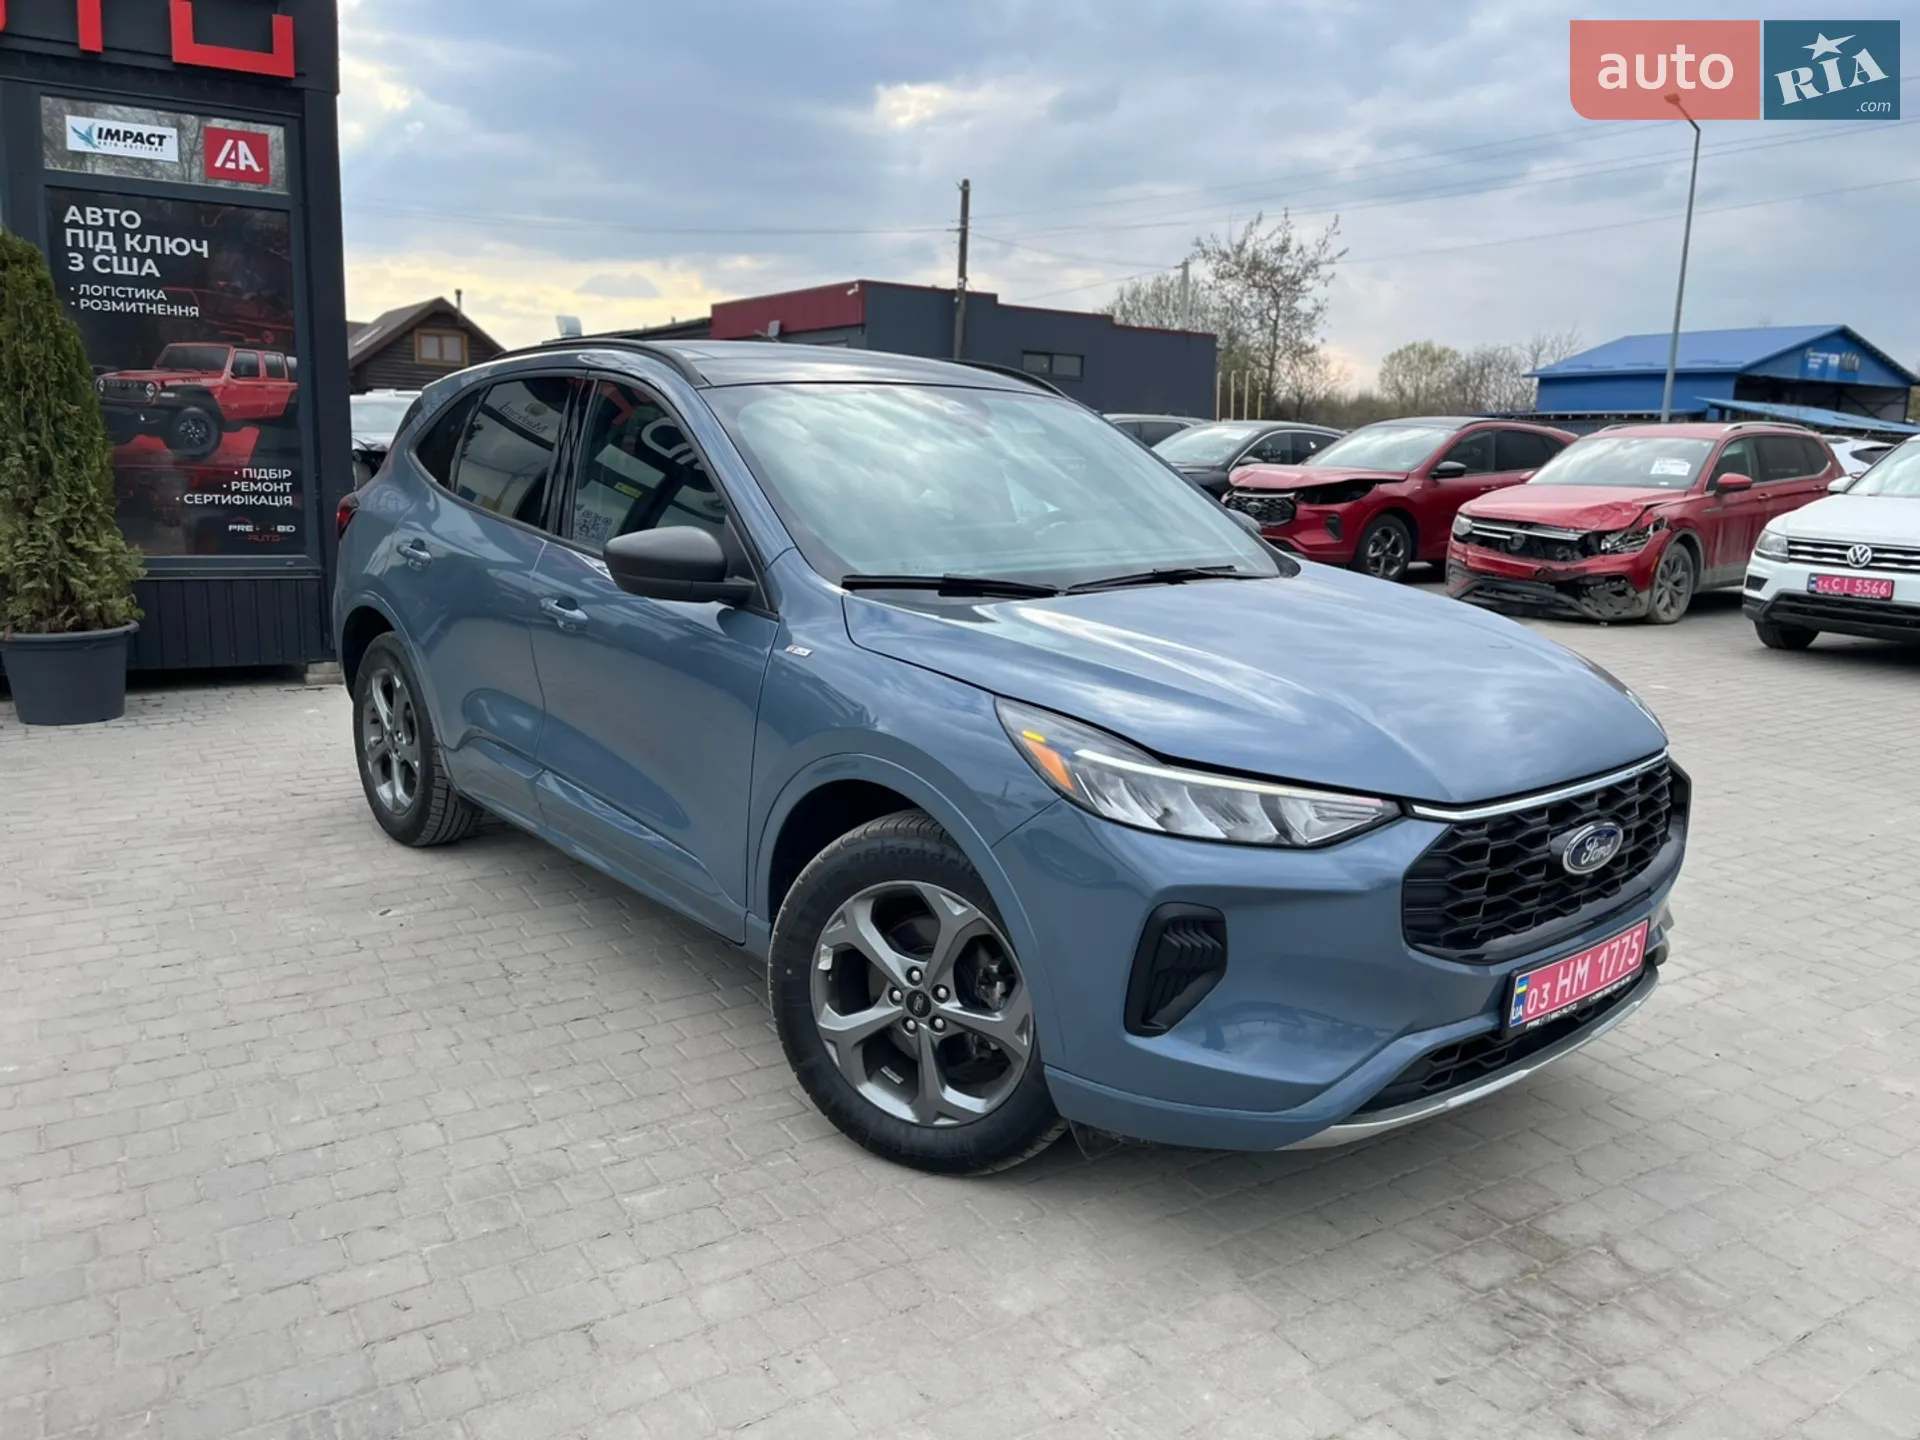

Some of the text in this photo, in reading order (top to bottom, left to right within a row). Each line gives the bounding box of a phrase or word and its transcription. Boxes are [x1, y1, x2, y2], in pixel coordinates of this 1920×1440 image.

[97, 127, 167, 147] IMPACT
[63, 205, 142, 229] АВТО
[65, 228, 209, 258] ПІД КЛЮЧ
[92, 254, 161, 278] США
[78, 284, 167, 300] ЛОГІСТИКА
[80, 298, 200, 318] РОЗМИТНЕННЯ
[242, 468, 292, 480] ПІДБІР
[231, 481, 293, 493] РЕМОНТ
[183, 494, 293, 507] СЕРТИФІКАЦІЯ
[1854, 579, 1888, 595] 5566
[1580, 835, 1616, 865] Ford
[1526, 982, 1551, 1015] 03
[1554, 954, 1591, 1003] HM
[1598, 929, 1642, 983] 1775
[1511, 1004, 1523, 1020] UA
